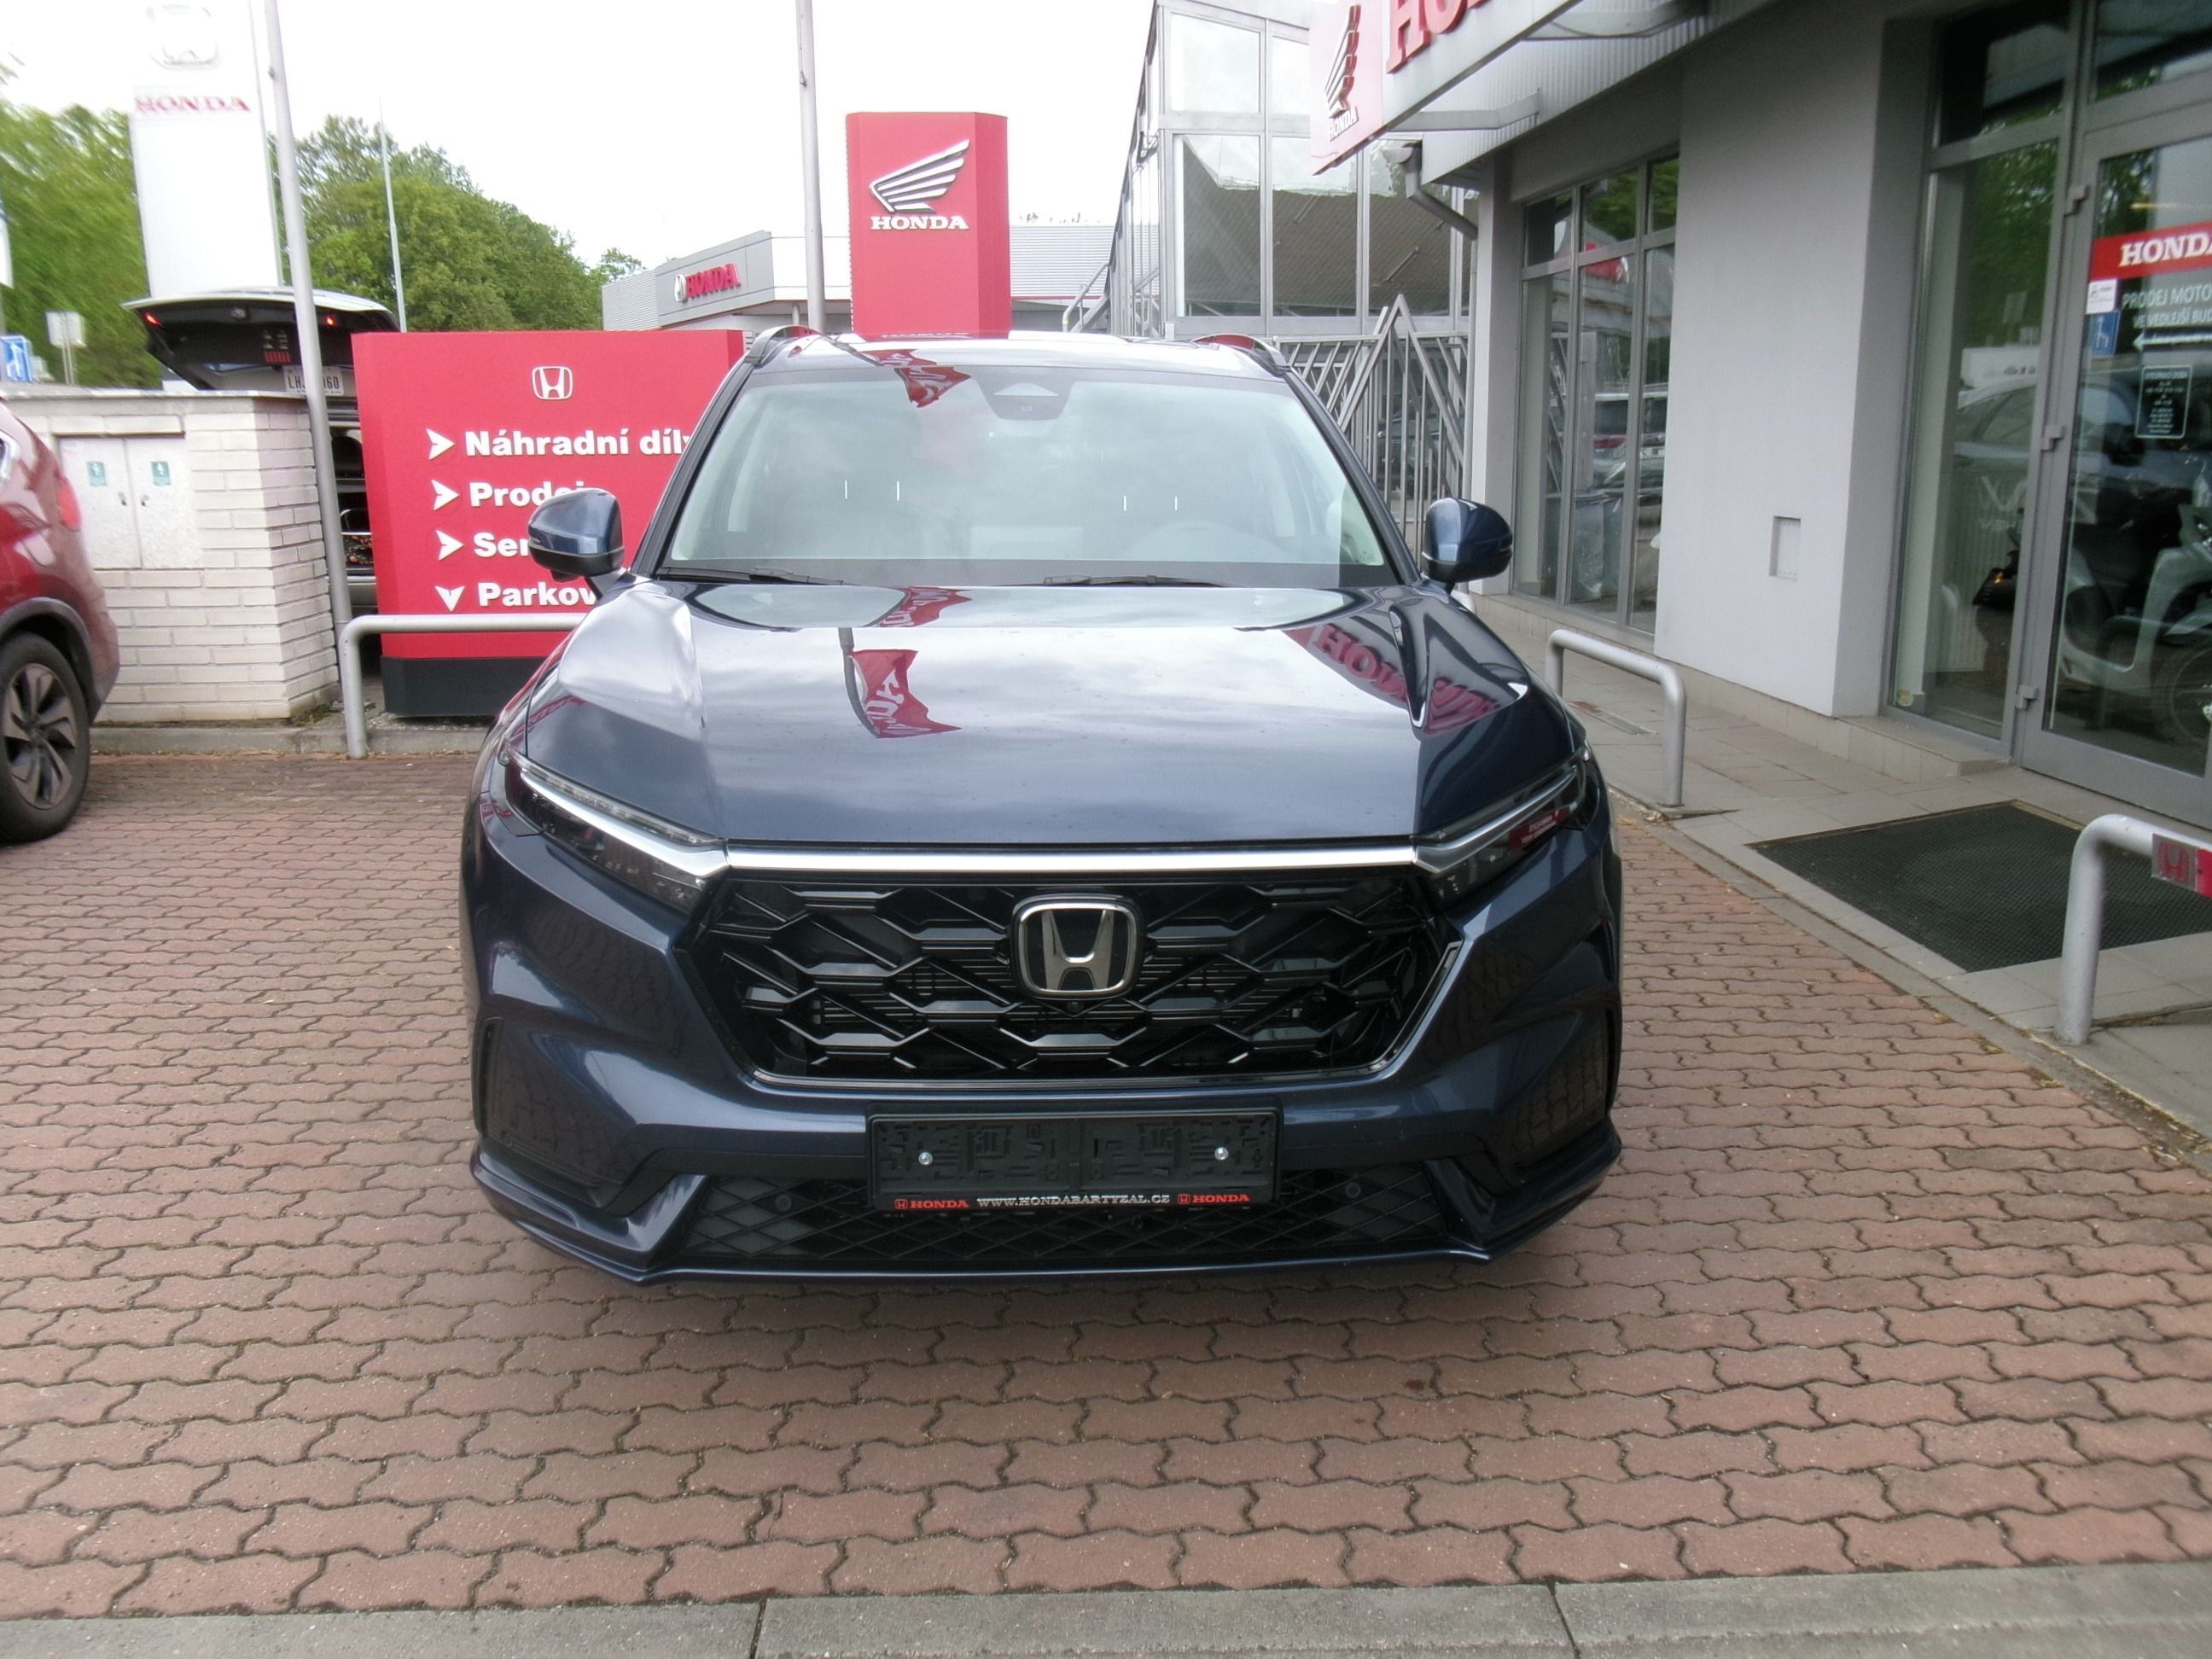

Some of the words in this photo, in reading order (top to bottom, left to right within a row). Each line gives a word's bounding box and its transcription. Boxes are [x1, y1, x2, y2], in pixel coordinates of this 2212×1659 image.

[134, 95, 251, 113] HONDA
[1328, 107, 1359, 142] HONDA
[870, 215, 969, 230] HONDA
[2119, 232, 2212, 267] HOND
[685, 262, 741, 299] HONDA
[465, 428, 629, 457] Náhradní
[469, 480, 585, 507] Prod
[911, 1199, 969, 1209] HONDA
[977, 1195, 1170, 1207] WWW.HONDABARTYZAL.CZ
[1192, 1194, 1250, 1203] HONDA
